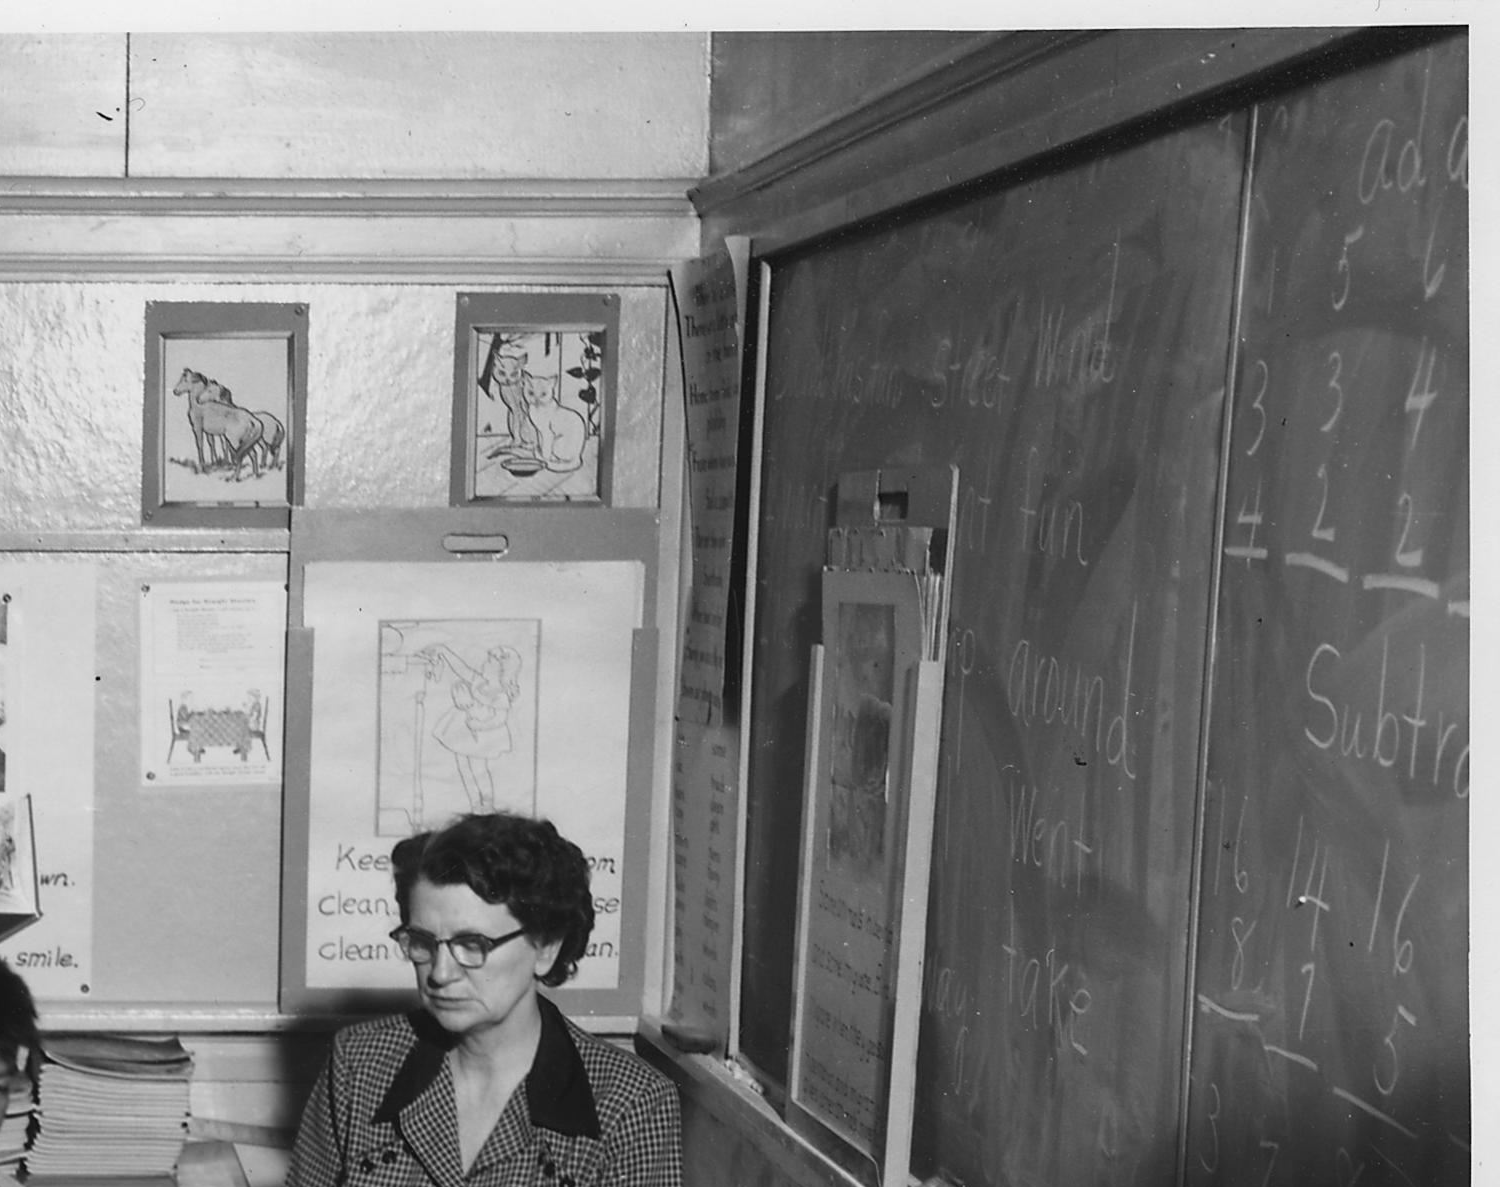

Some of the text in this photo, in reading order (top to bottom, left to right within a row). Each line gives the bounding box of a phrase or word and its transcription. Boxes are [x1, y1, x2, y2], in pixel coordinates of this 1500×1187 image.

[1320, 351, 1342, 432] 3
[1405, 336, 1438, 450] 4
[1396, 493, 1423, 567] 2
[336, 843, 391, 872] Kee
[15, 946, 78, 968] smile.
